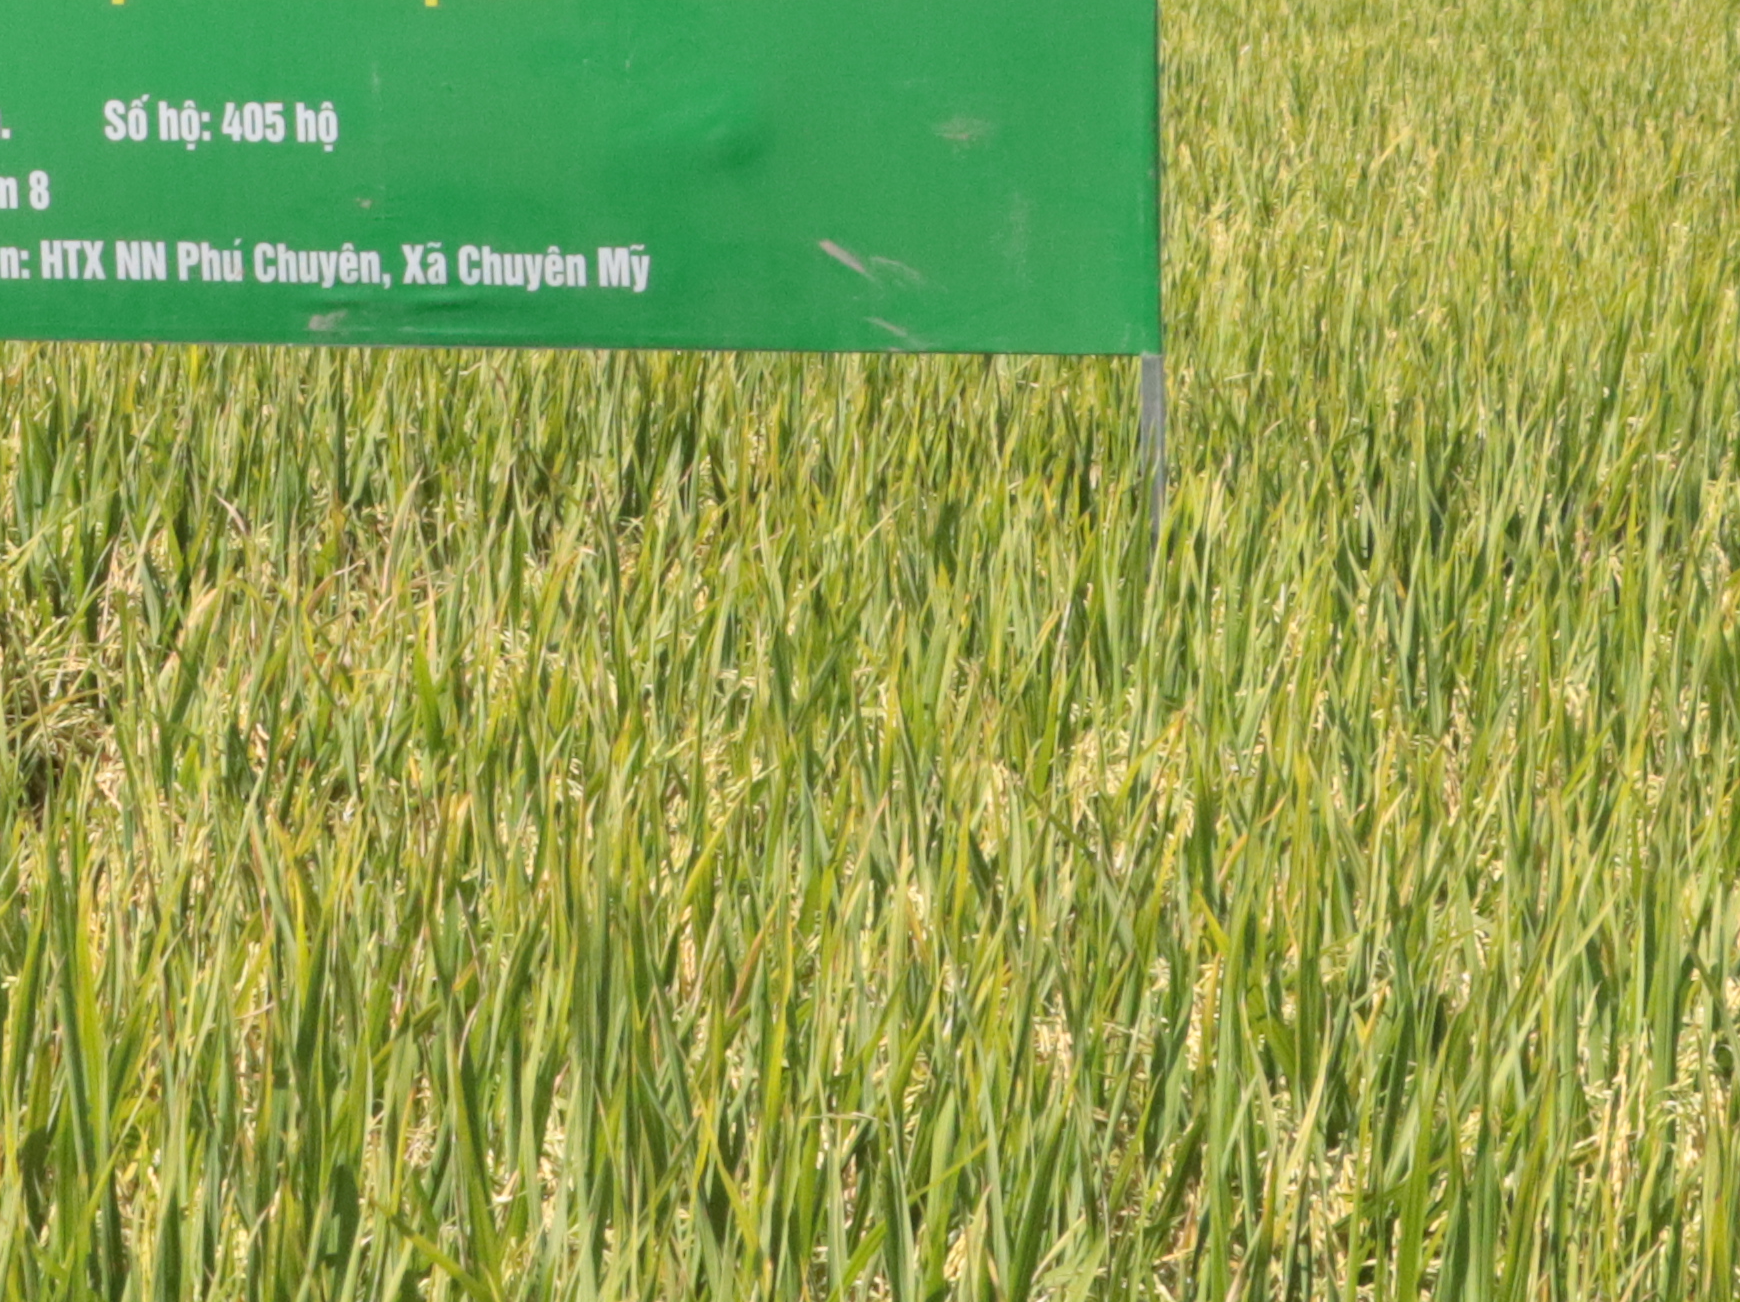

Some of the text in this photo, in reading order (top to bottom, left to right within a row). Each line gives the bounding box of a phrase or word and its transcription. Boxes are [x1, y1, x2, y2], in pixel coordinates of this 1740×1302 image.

[104, 95, 149, 140] Số
[159, 101, 210, 149] hộ:
[222, 103, 285, 142] 405
[296, 102, 337, 151] hộ
[29, 171, 49, 209] 8
[41, 241, 105, 279] HTX
[116, 241, 166, 279] NN
[178, 240, 243, 281] Phú
[255, 243, 390, 287] Chuyên,
[403, 243, 446, 283] Xã
[459, 246, 586, 290] Chuyên
[598, 245, 649, 291] Mỹ
